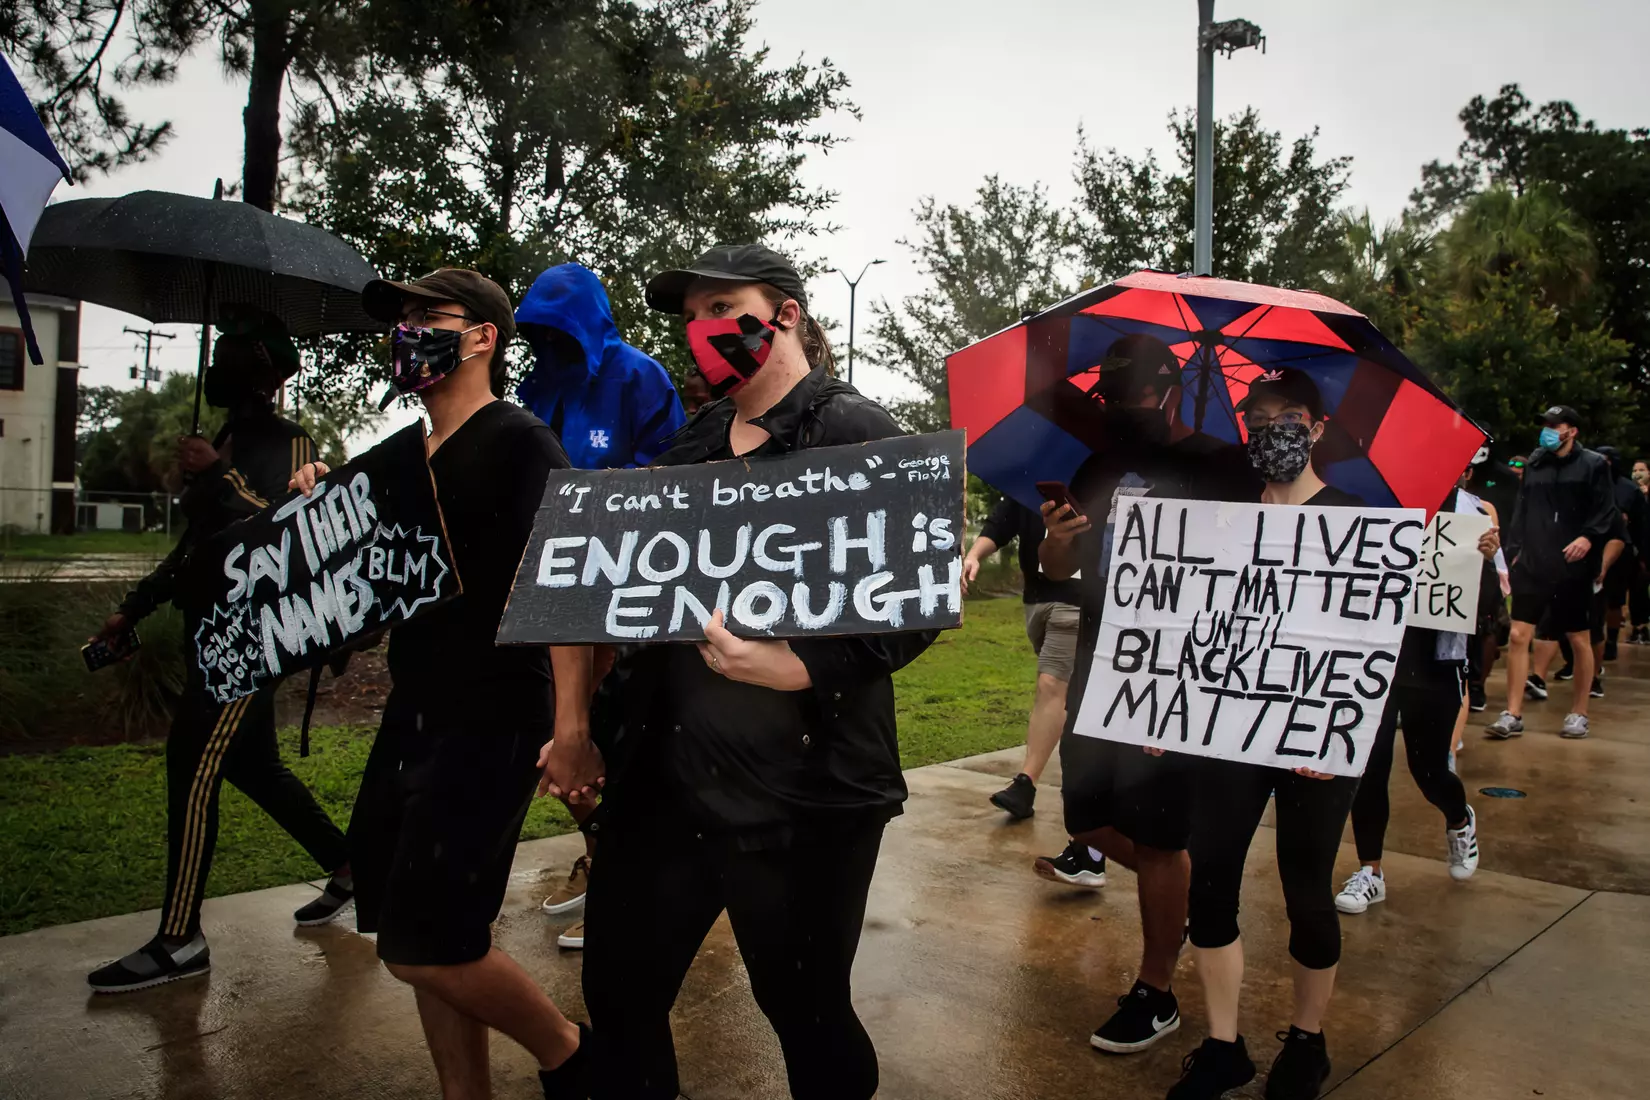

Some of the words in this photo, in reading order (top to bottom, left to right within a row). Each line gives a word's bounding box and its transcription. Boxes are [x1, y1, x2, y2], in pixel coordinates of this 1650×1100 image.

[898, 455, 951, 471] George
[908, 466, 951, 482] Floyd
[606, 485, 690, 512] can't
[224, 527, 291, 602] SAY
[272, 472, 378, 577] THEIR
[369, 547, 428, 590] BLM
[536, 509, 886, 588] ENOUGH
[911, 511, 955, 553] is
[1117, 503, 1214, 564] ALL
[1252, 511, 1424, 571] LIVES
[260, 556, 374, 677] NAMES
[606, 555, 962, 638] ENOUGH
[1114, 562, 1238, 613] CAN'T
[1231, 564, 1415, 625] MATTER
[1415, 582, 1467, 620] TER
[217, 648, 239, 674] no
[1191, 610, 1306, 651] UNTIL
[1112, 629, 1256, 691] BLACK
[1255, 648, 1397, 700] LIVES
[1102, 678, 1364, 764] MATTER
